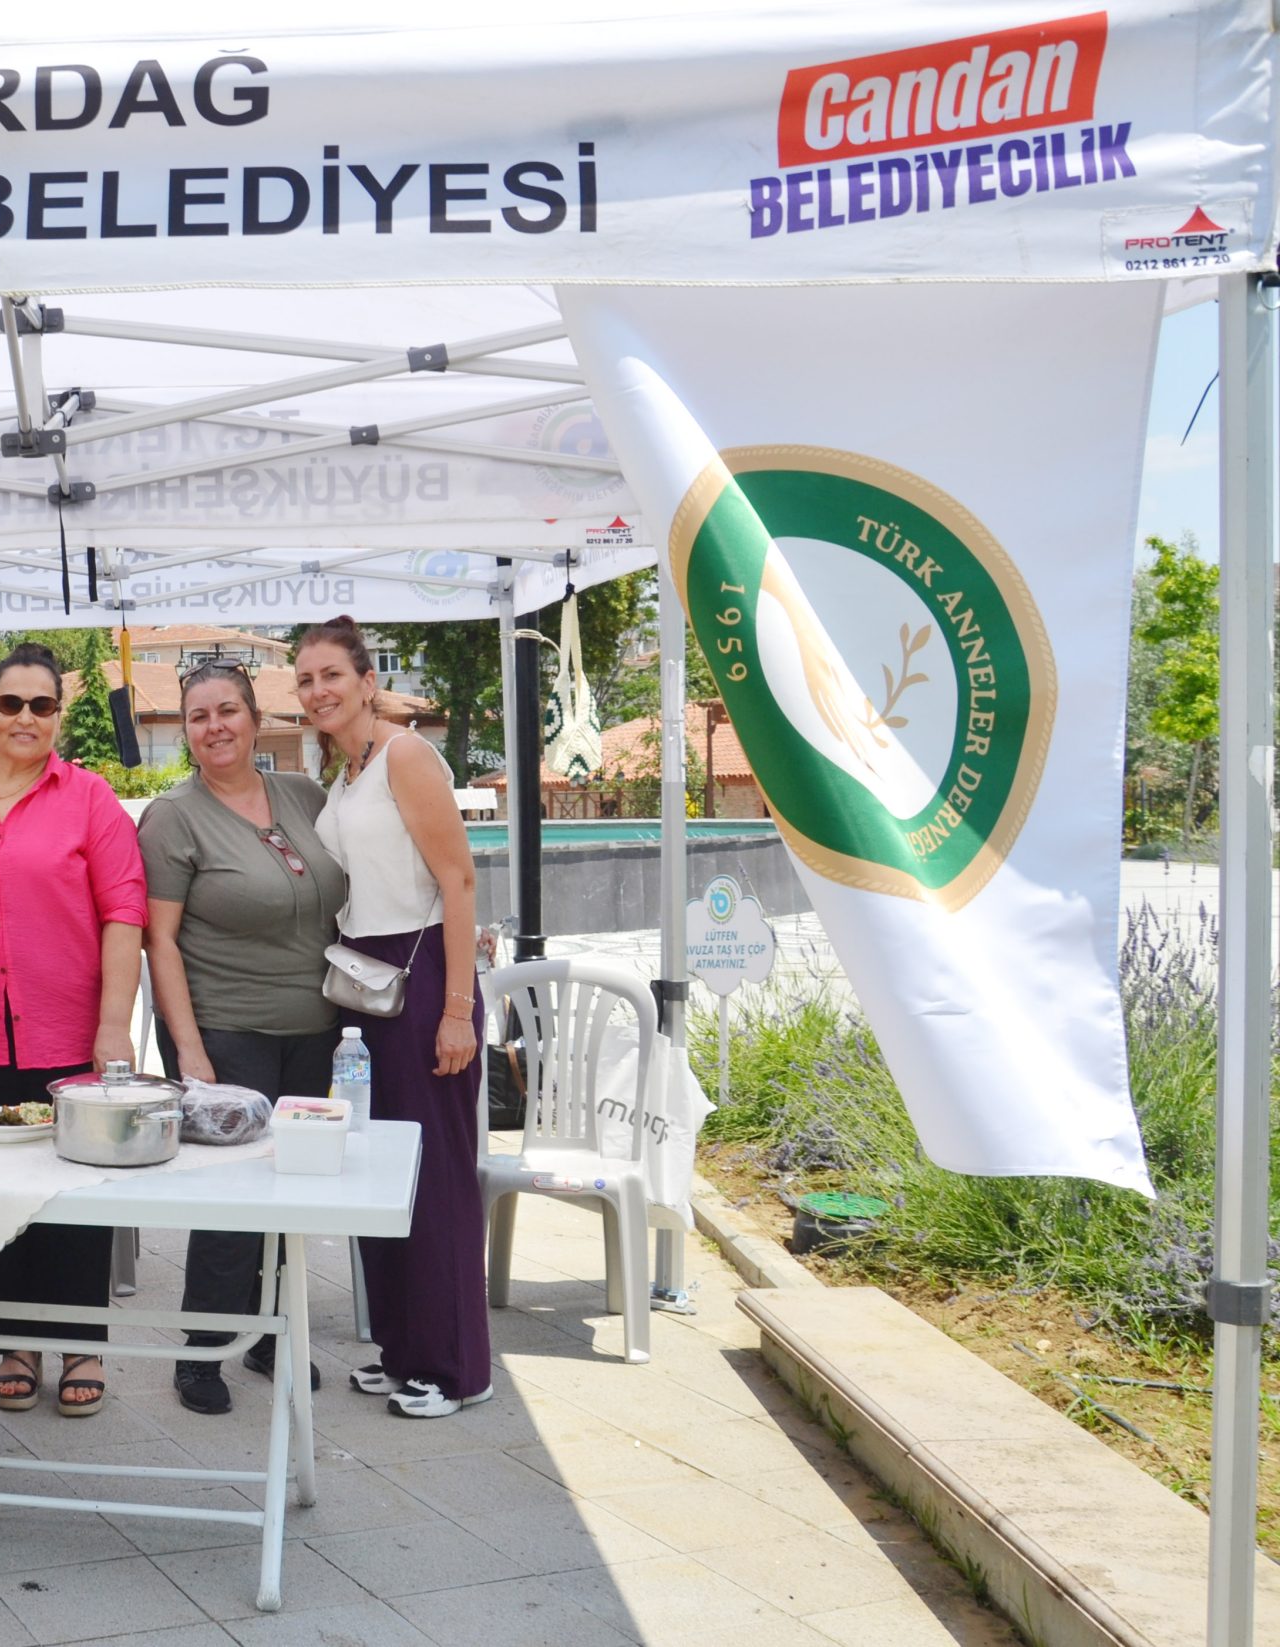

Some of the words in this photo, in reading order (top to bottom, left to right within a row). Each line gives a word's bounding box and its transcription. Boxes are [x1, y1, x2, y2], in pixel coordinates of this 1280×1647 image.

[804, 39, 1079, 151] Candan
[750, 122, 1137, 239] BELEDİYECİLİK
[1125, 233, 1229, 250] PROTENT
[1125, 260, 1159, 271] 0212
[1163, 258, 1187, 269] 861
[1192, 256, 1208, 266] 27
[1214, 254, 1231, 264] 20
[716, 580, 748, 682] 1959
[857, 515, 944, 588] TÜRK
[937, 591, 997, 757] ANNELER
[705, 928, 737, 941] LÜTFEN
[716, 945, 731, 957] TAŞ
[735, 944, 745, 954] VE
[748, 941, 767, 957] ÇÖP
